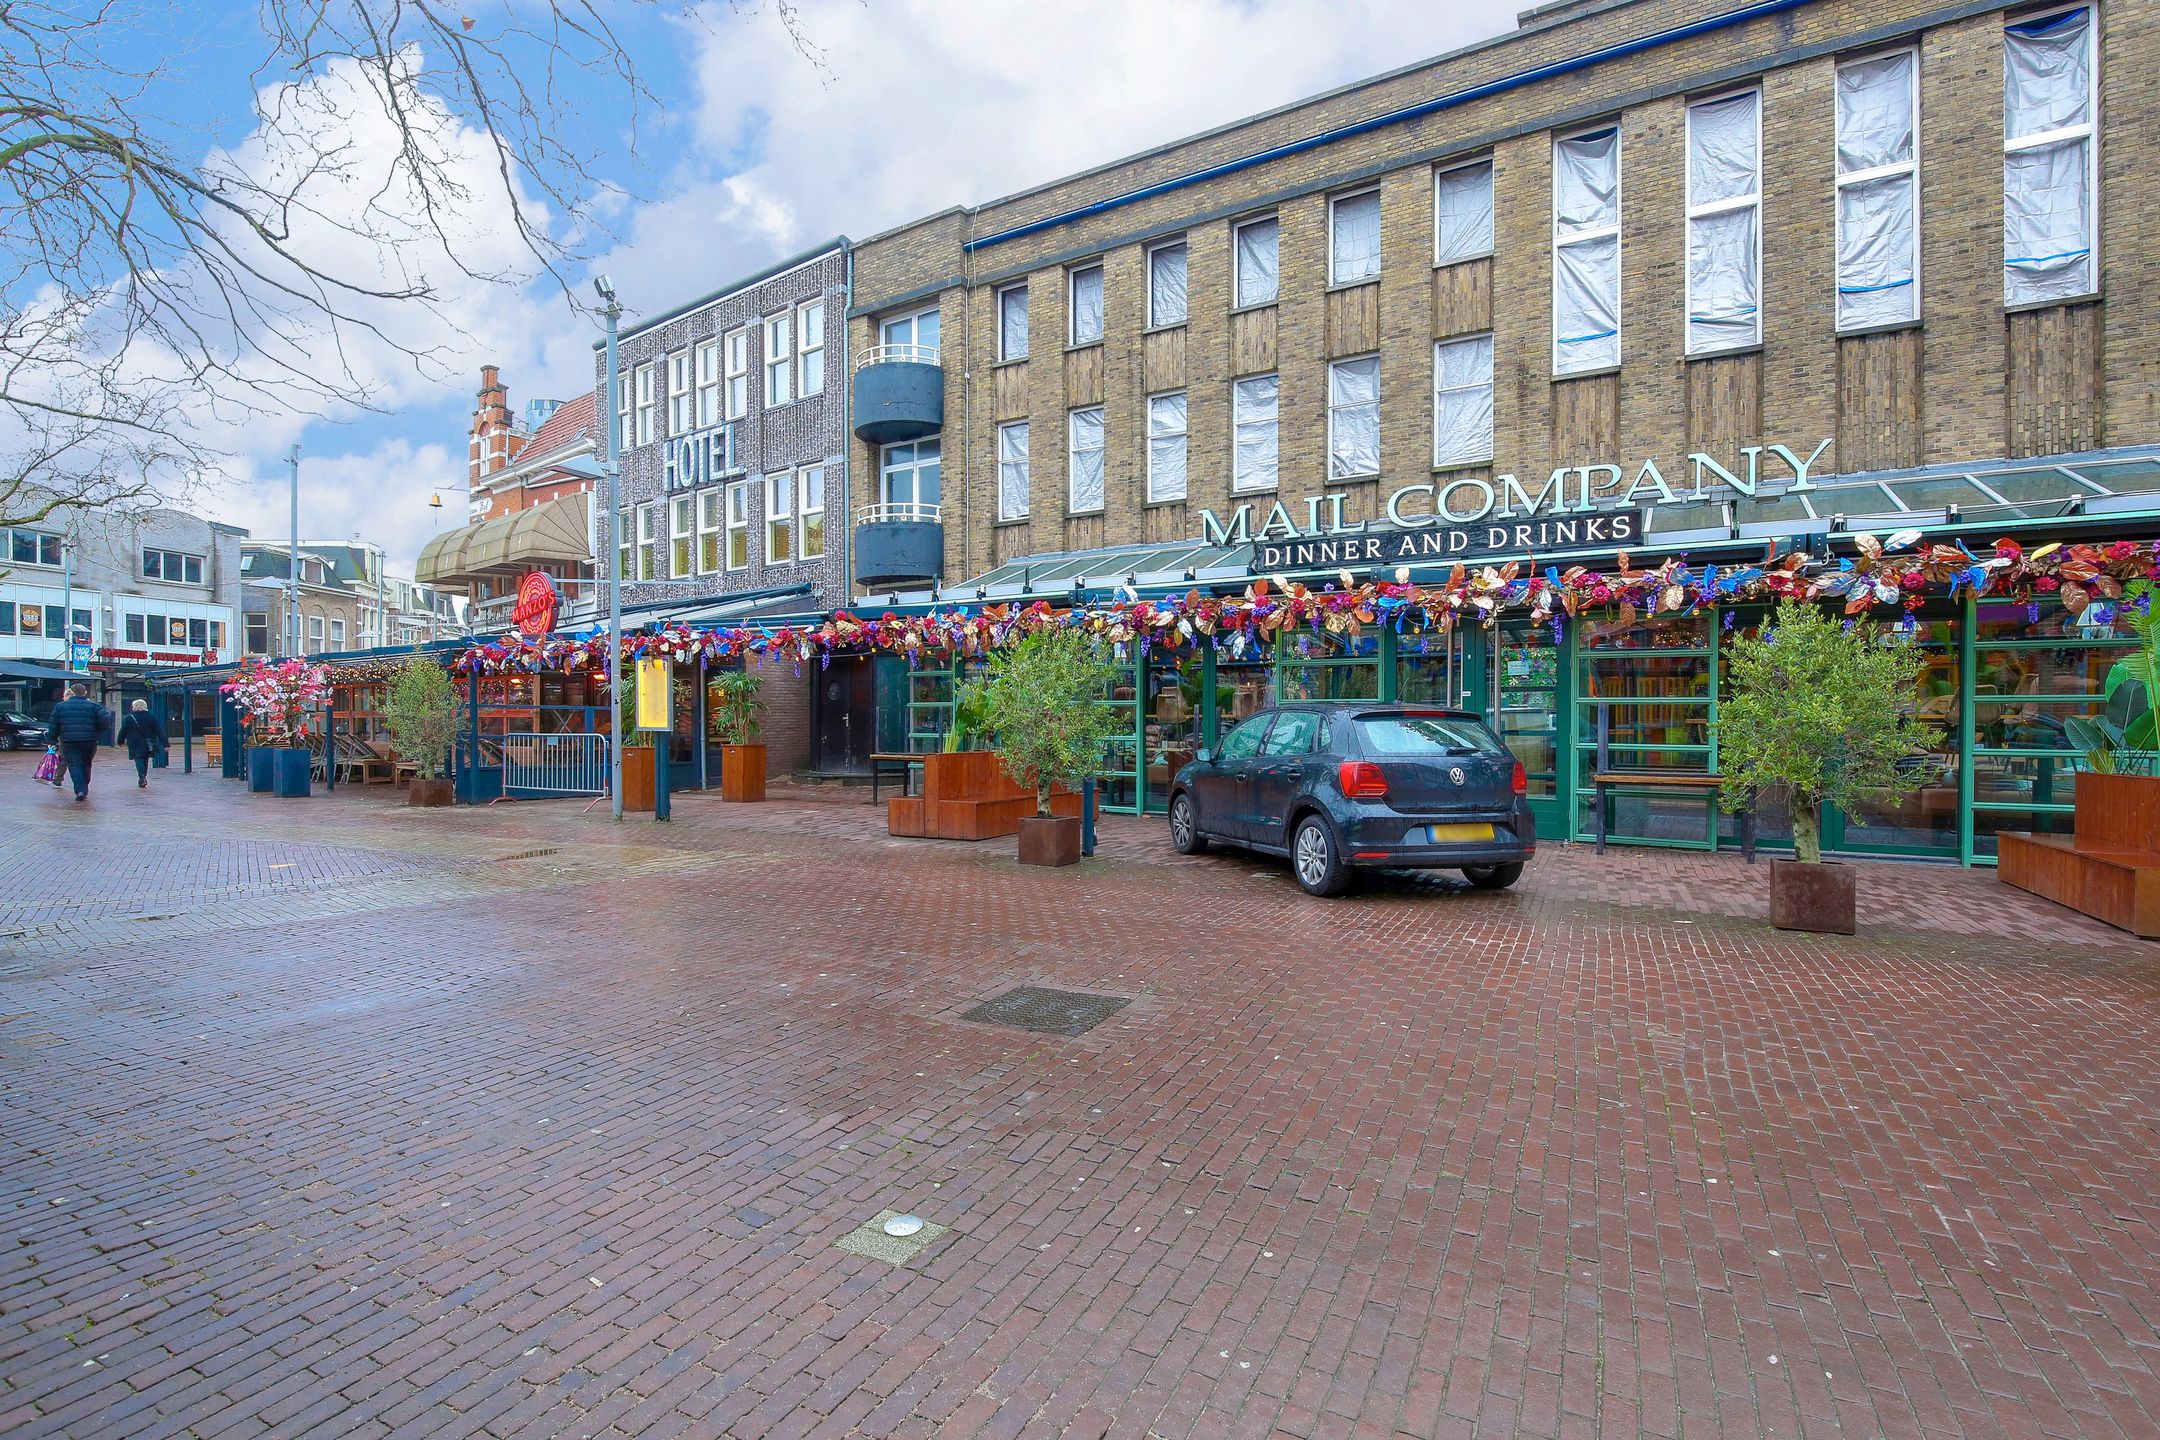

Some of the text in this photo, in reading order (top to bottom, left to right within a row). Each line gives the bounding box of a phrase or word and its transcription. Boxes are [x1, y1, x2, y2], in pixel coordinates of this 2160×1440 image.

[664, 422, 746, 492] HOTEL
[1198, 438, 1833, 547] MAIL COMPANY
[1264, 515, 1632, 567] DINNER AND DRINKS
[511, 589, 557, 625] MANZO'S
